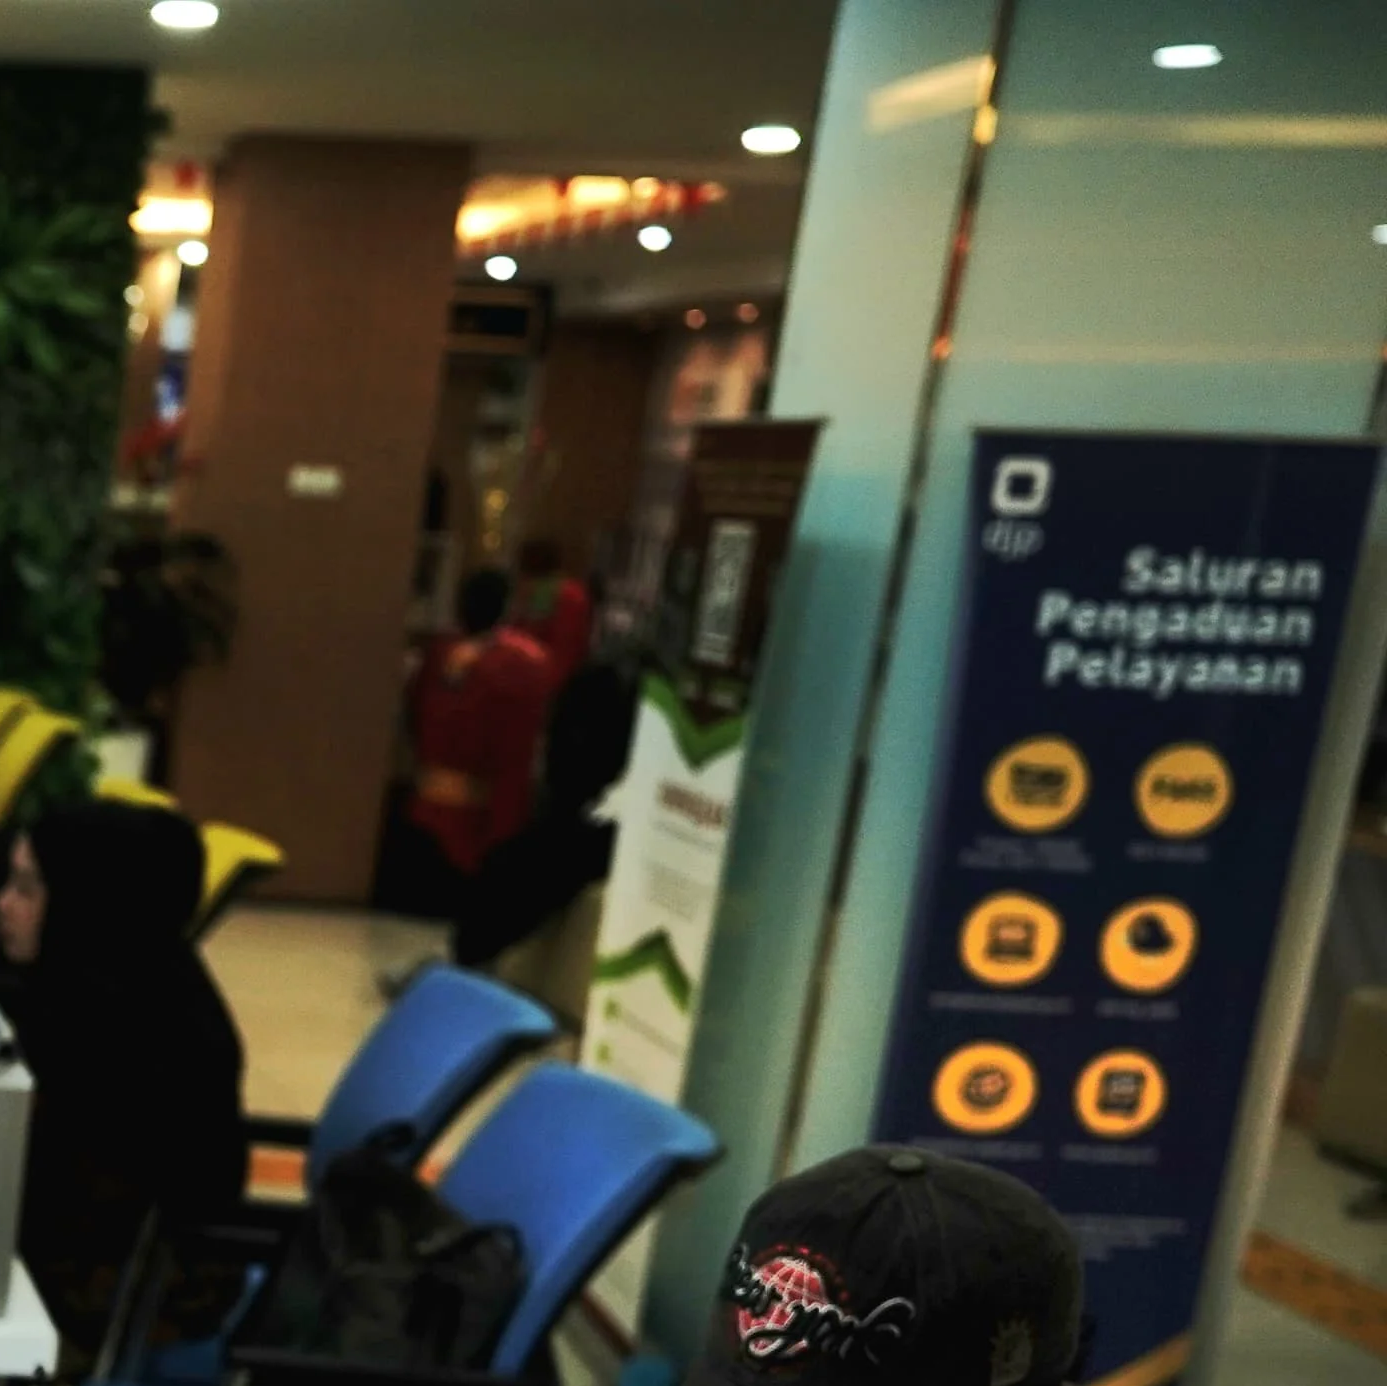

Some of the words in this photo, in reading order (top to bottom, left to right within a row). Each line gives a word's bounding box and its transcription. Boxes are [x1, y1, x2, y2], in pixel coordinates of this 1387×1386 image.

[1123, 546, 1324, 598] Saluran
[1036, 589, 1315, 648] Pengaduan
[1043, 641, 1305, 698] Pelayanan
